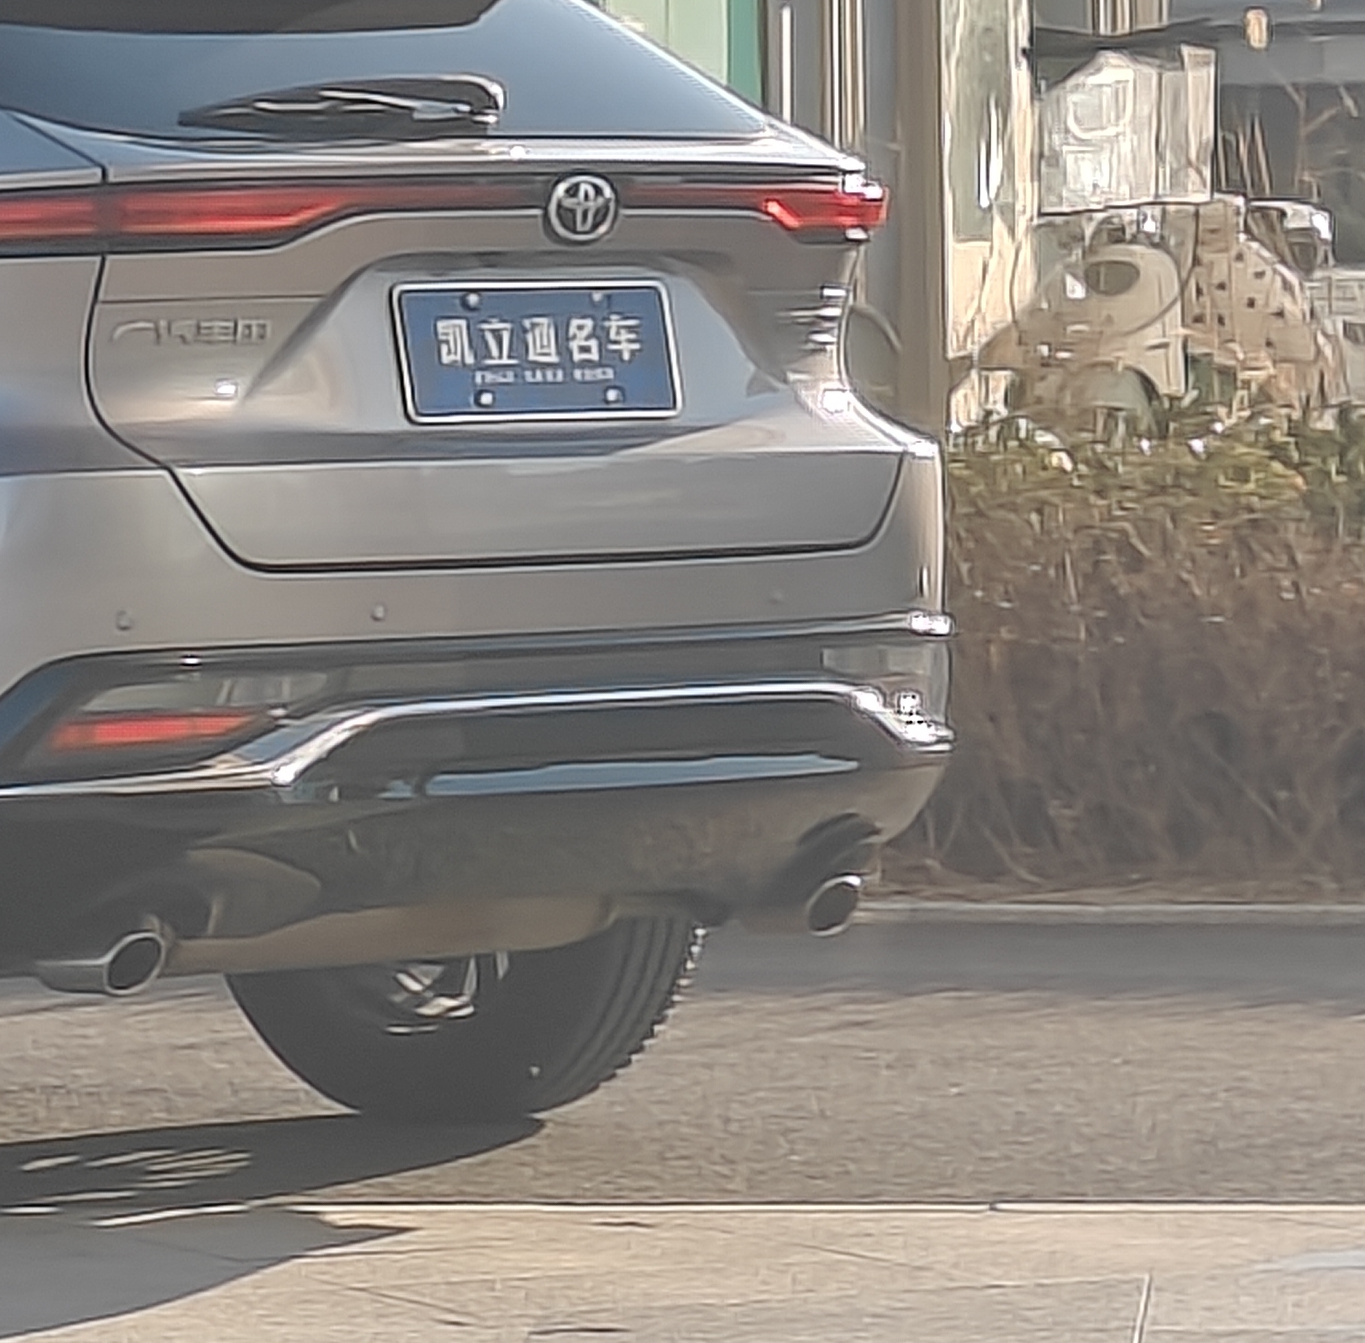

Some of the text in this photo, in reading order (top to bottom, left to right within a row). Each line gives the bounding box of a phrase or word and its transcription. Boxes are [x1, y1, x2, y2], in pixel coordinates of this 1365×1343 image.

[436, 313, 642, 366] 凯立通名车
